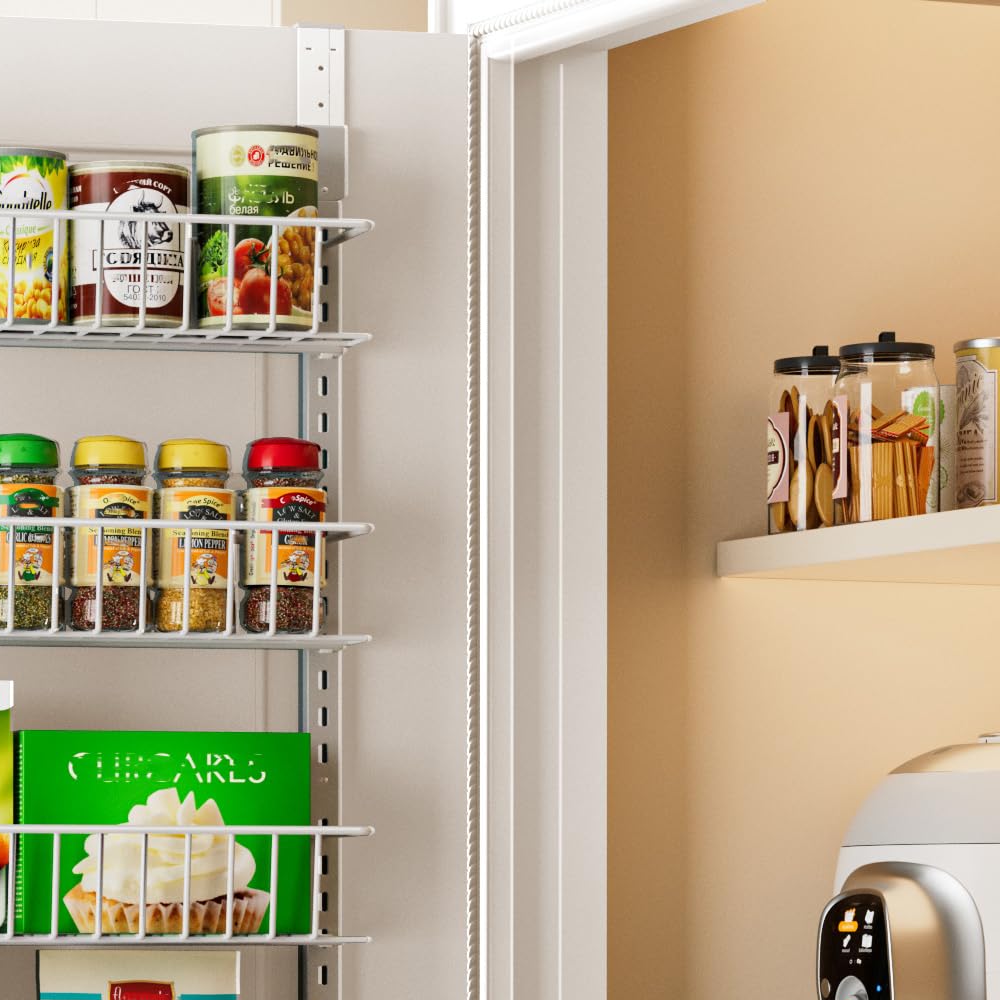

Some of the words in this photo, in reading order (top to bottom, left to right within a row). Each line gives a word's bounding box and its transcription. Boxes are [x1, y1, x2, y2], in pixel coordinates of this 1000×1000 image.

[153, 180, 172, 194] СОРТ
[229, 204, 259, 215] белая
[127, 284, 154, 294] ГОТ
[172, 530, 209, 538] Seaning
[179, 539, 203, 549] LON
[205, 540, 226, 550] PEPPER
